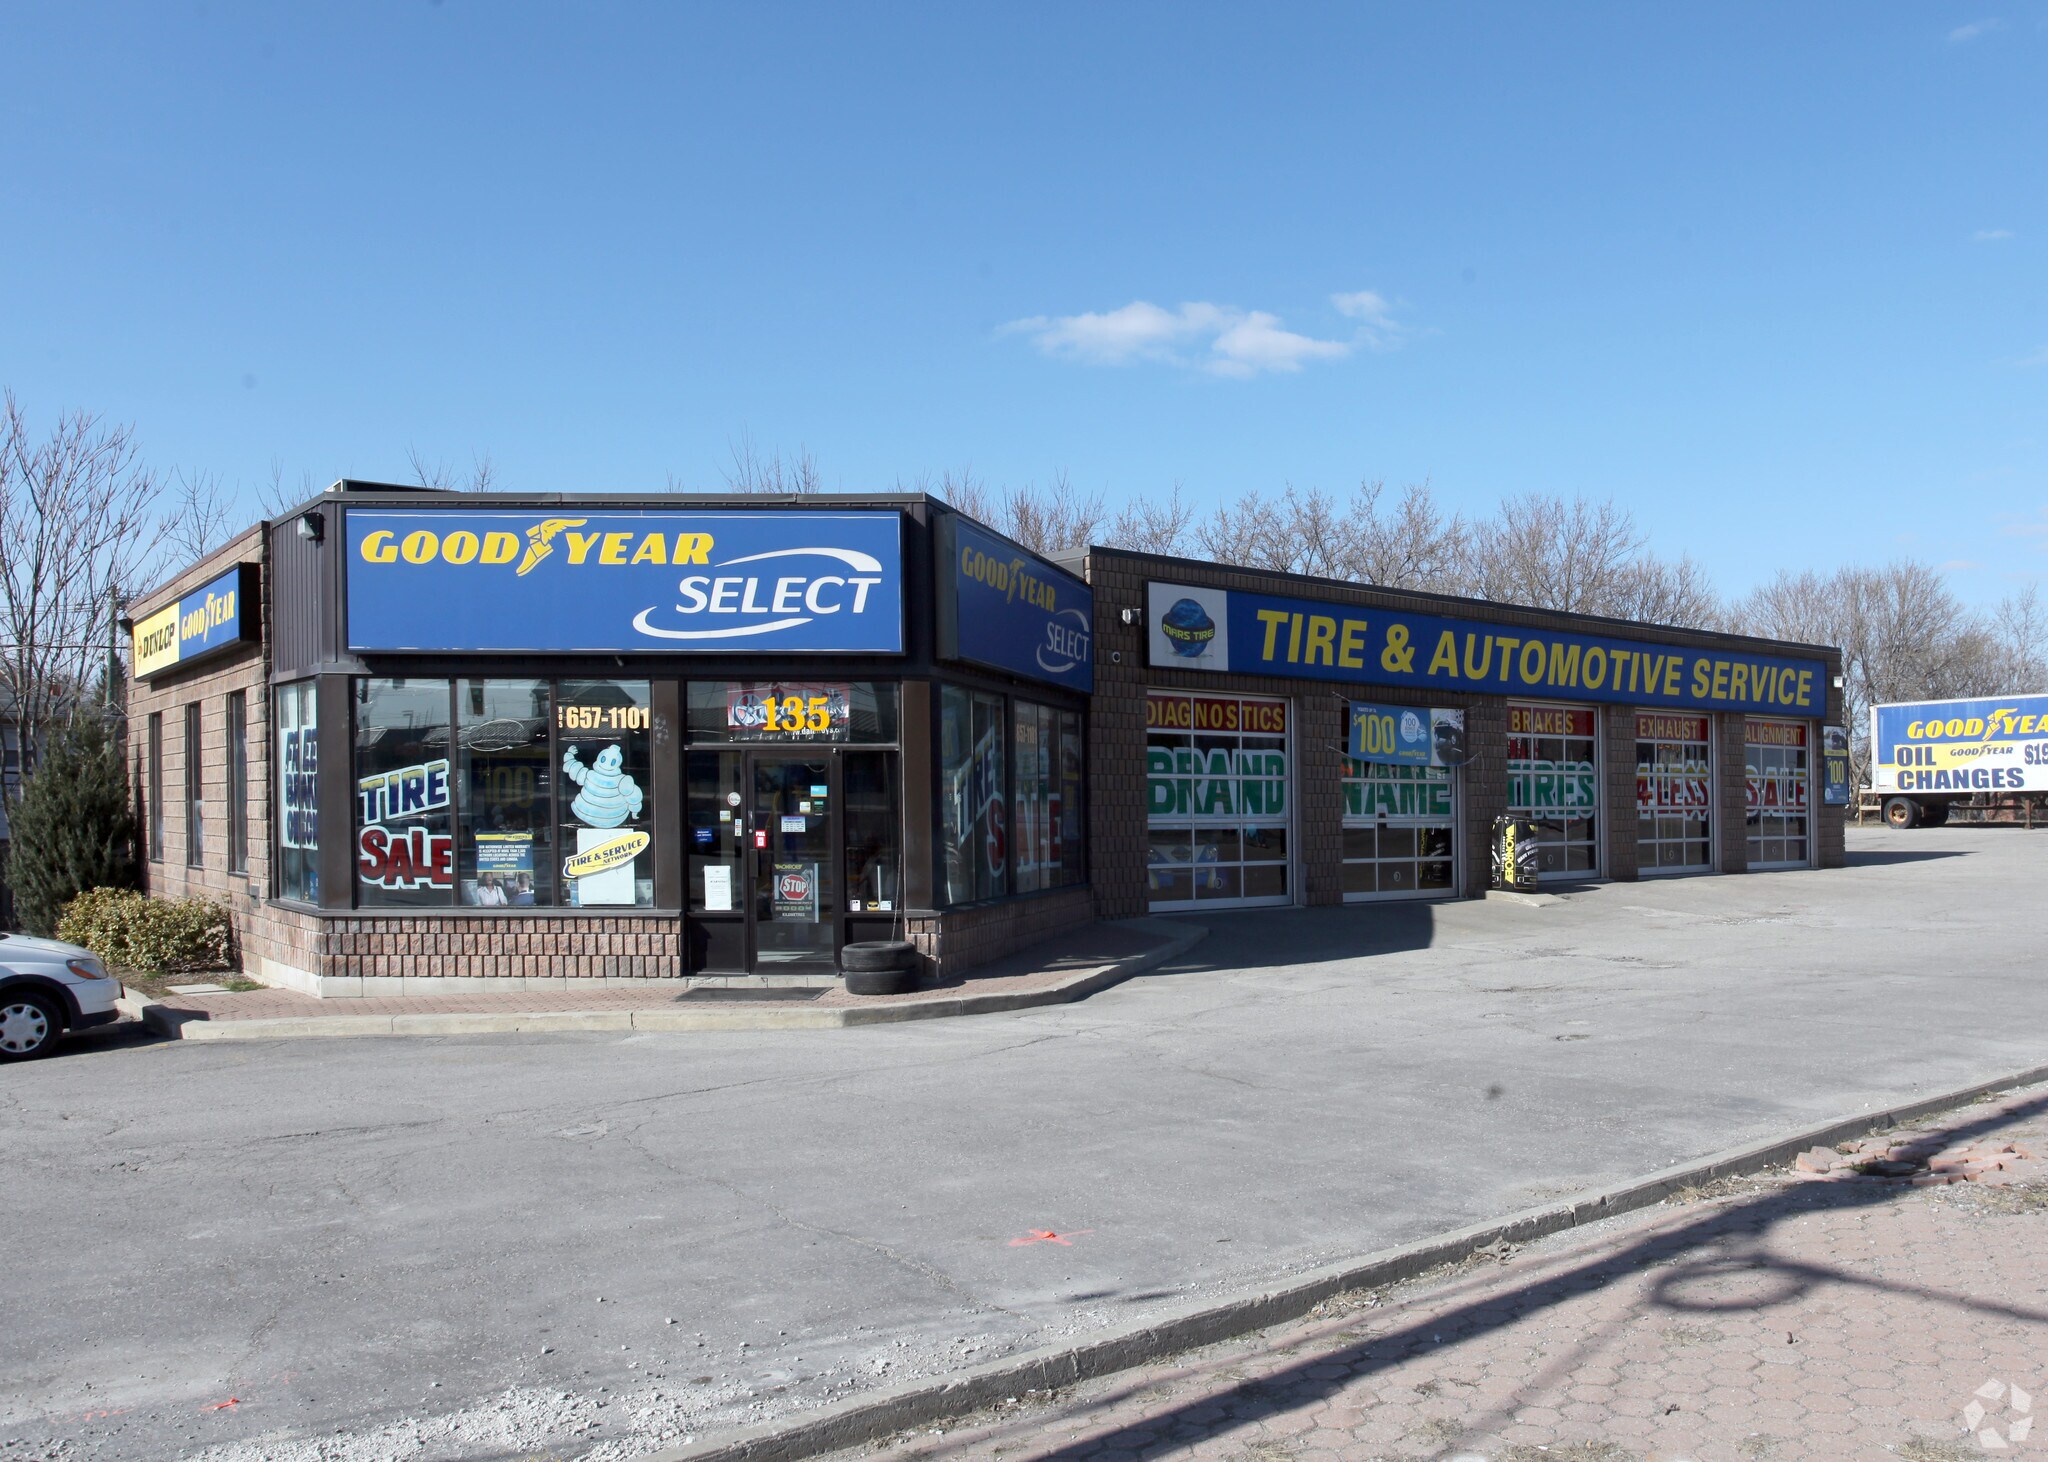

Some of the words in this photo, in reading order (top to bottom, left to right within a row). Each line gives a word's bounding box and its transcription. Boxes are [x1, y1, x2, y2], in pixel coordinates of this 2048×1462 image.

[676, 575, 882, 614] SELECT
[143, 621, 175, 659] DUNLOP
[1046, 621, 1090, 663] SELECT
[1163, 623, 1191, 641] MARS
[1193, 628, 1214, 641] TIRE
[1256, 608, 1368, 669] TIRE
[1381, 623, 1414, 674] &
[1428, 630, 1684, 696] AUTOMOTIVE
[1691, 658, 1813, 707] SERVICE
[566, 706, 650, 729] 657-1101
[761, 696, 831, 732] 135
[1146, 700, 1284, 731] DIAGNOSTICS
[1511, 710, 1574, 734] BRAKES
[1639, 718, 1698, 740] EXHAUST
[1745, 725, 1802, 745] ALIGNMENT
[1896, 746, 1937, 767] OIL
[359, 760, 449, 822] TIRE
[1147, 749, 1286, 816] BRAND
[1342, 758, 1451, 816] NAME
[1507, 762, 1595, 817] TIRES
[1745, 767, 1807, 815] SALE
[1896, 767, 2025, 790] CHANGES
[360, 827, 453, 888] SALE
[571, 854, 592, 868] TIRE
[594, 852, 601, 861] &
[602, 838, 642, 859] SERVICE
[603, 851, 633, 864] NETWORK
[782, 878, 807, 894] STOP
